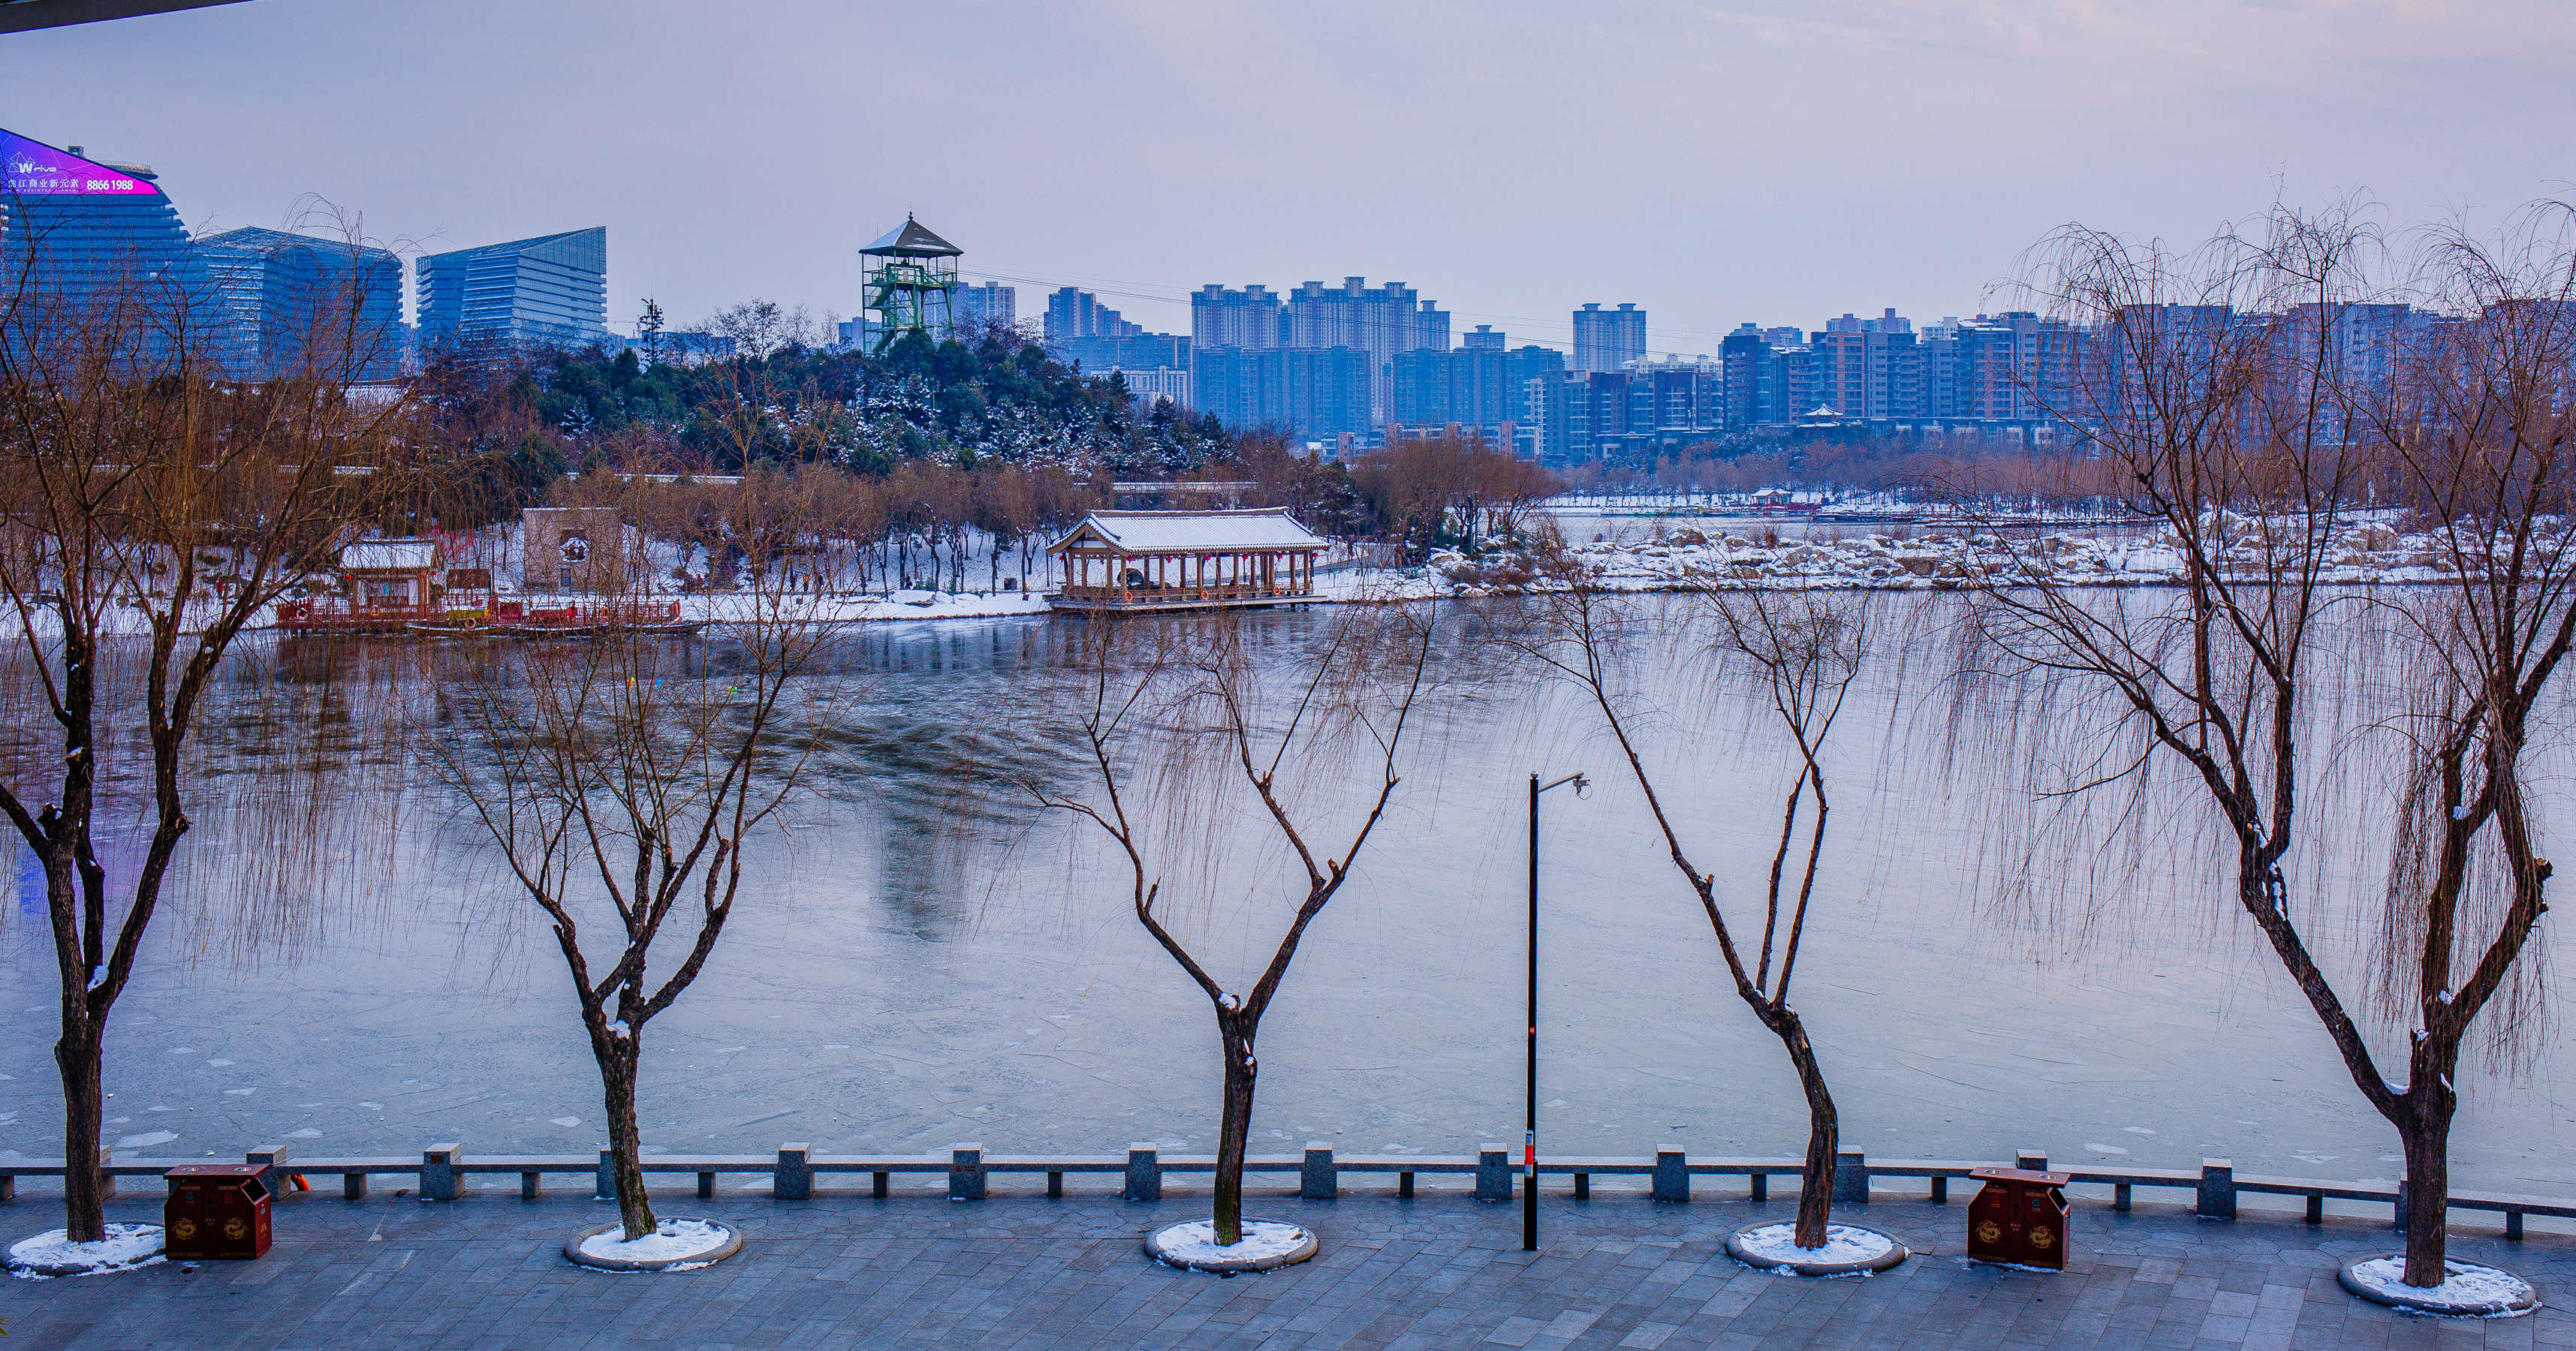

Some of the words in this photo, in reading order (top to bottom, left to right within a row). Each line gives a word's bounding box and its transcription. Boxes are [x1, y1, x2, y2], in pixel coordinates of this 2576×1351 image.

[8, 179, 79, 188] 曲江商业新元素
[86, 179, 110, 191] 8866
[110, 179, 134, 191] 1988
